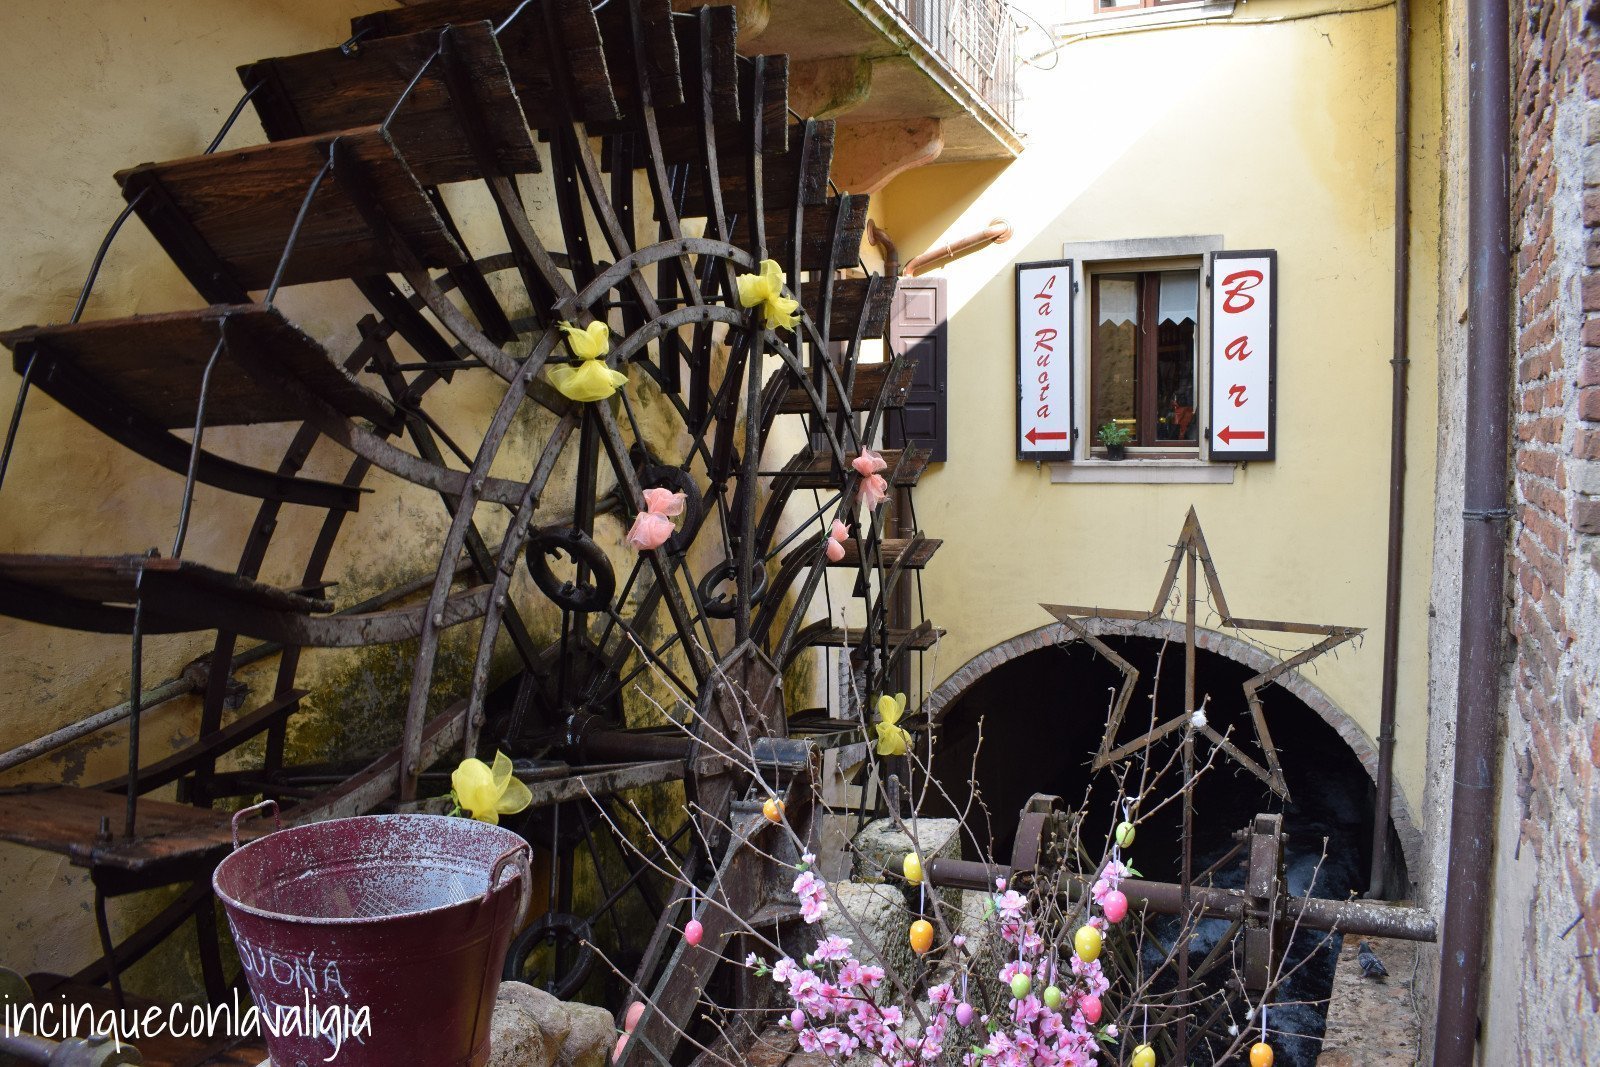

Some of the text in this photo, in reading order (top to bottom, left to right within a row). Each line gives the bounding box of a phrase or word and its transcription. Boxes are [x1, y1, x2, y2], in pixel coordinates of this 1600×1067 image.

[1033, 274, 1058, 419] La Ruota
[1221, 269, 1264, 408] Bar
